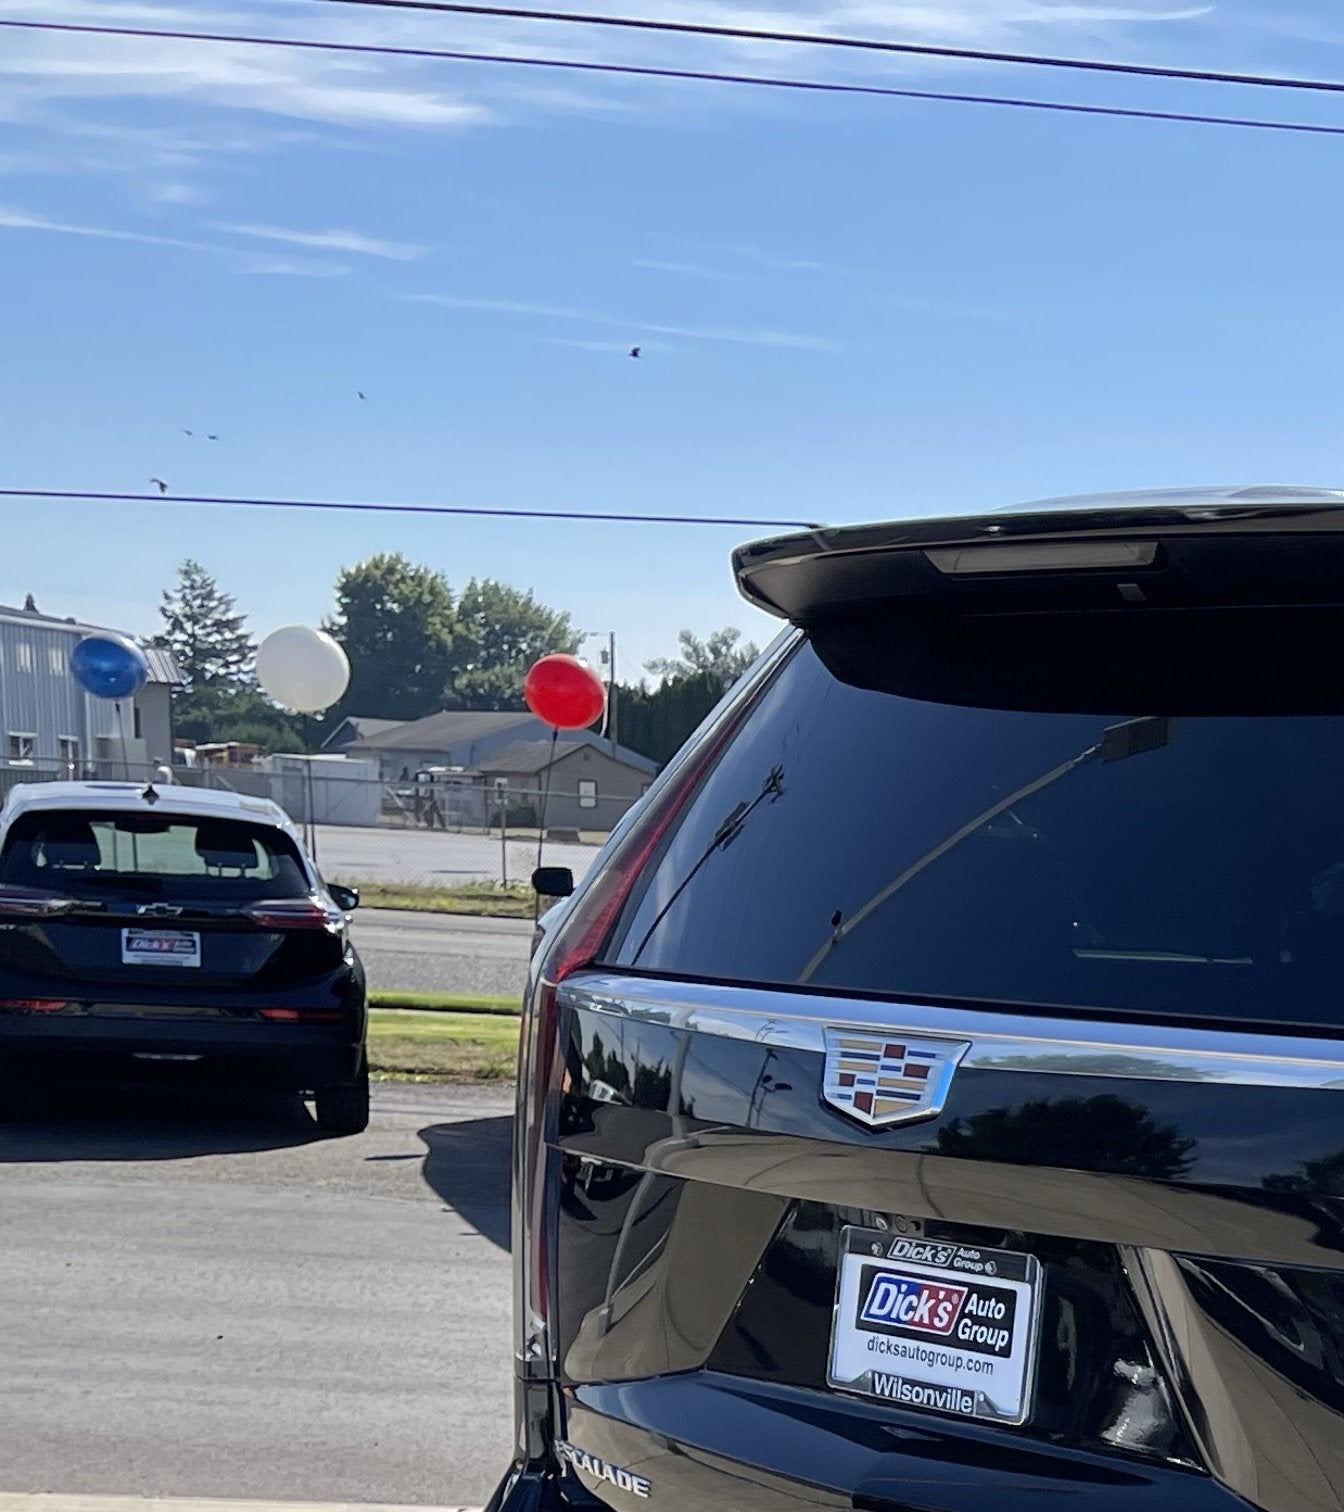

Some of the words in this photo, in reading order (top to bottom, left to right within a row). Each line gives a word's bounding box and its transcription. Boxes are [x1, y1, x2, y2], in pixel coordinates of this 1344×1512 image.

[892, 1240, 948, 1263] Dick's
[953, 1257, 984, 1272] Group
[957, 1247, 981, 1260] Auto
[869, 1281, 953, 1329] Dick's
[964, 1292, 1006, 1319] Auto
[957, 1318, 1010, 1351] Group
[866, 1335, 994, 1376] dicksautogroup.com
[873, 1372, 974, 1414] Wilsonville
